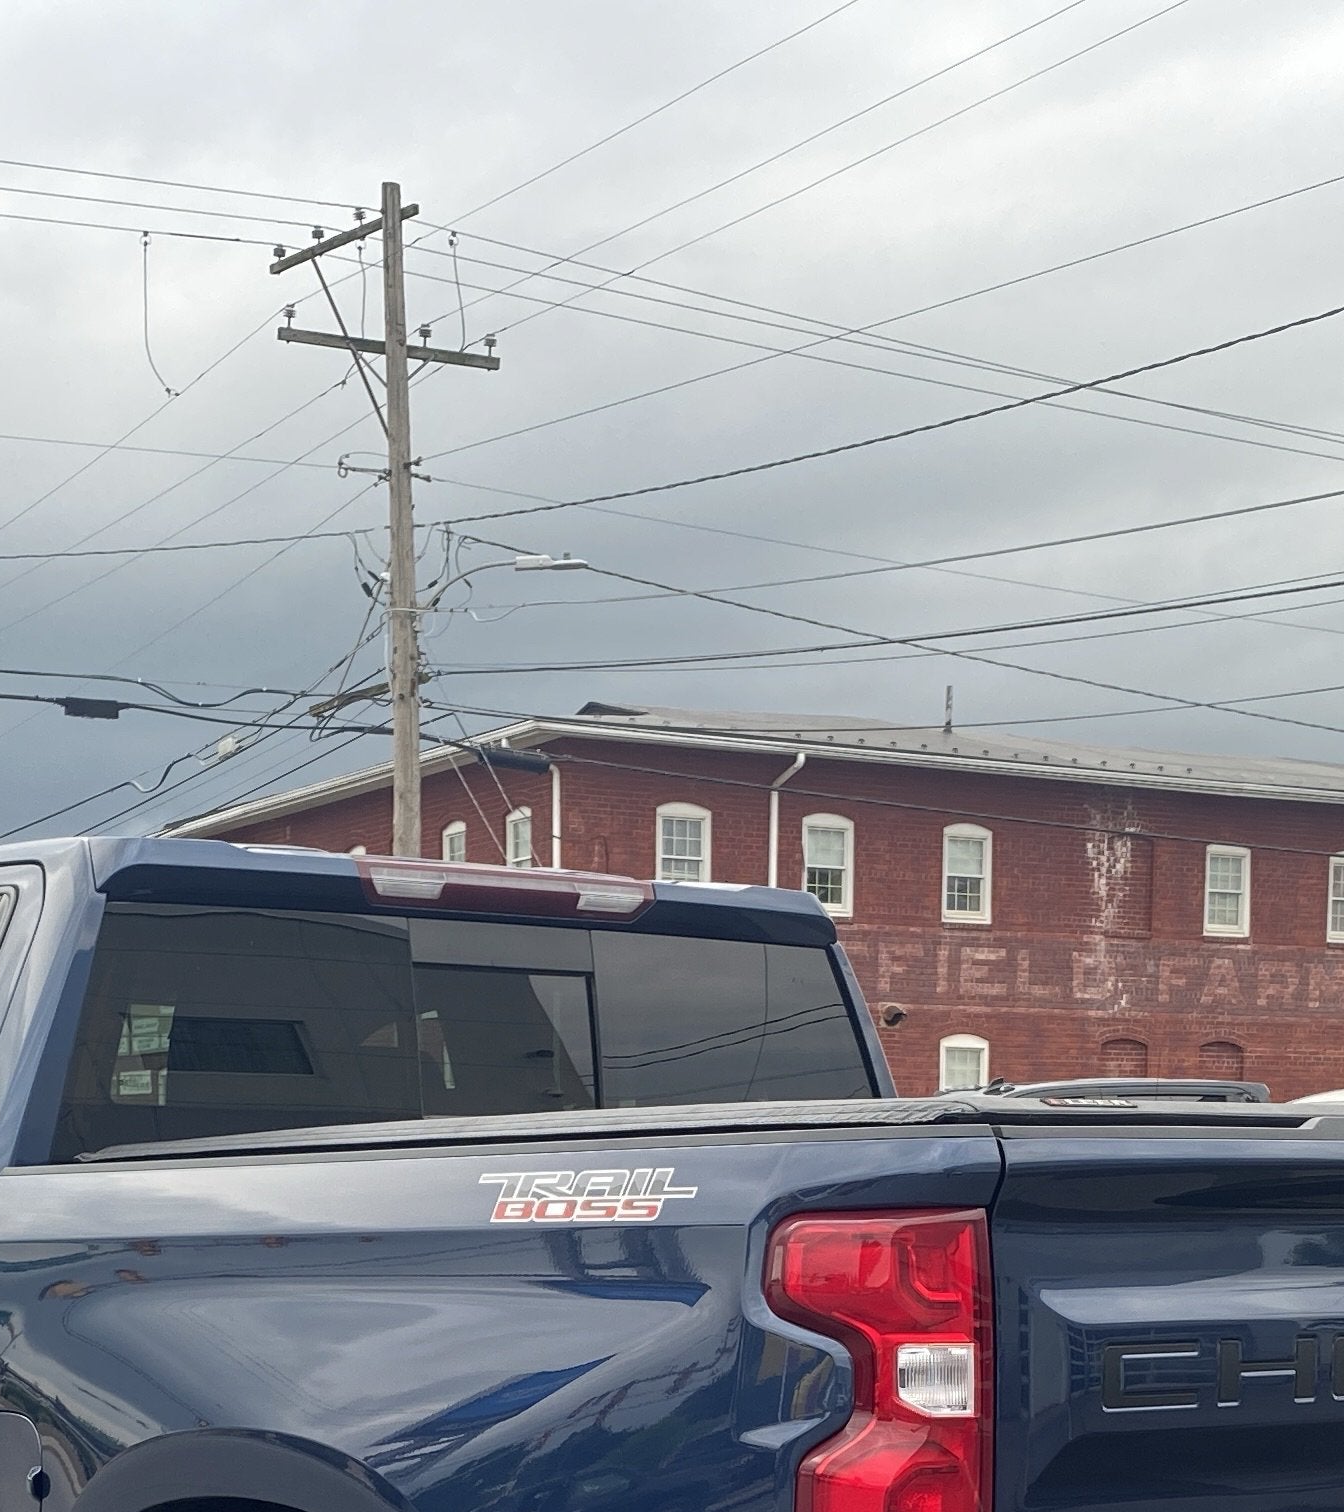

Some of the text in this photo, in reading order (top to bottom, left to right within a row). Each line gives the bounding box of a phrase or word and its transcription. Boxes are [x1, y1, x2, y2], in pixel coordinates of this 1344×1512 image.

[844, 941, 1117, 1001] FIELD
[478, 1167, 699, 1199] TRAIL
[490, 1198, 664, 1223] BOSS
